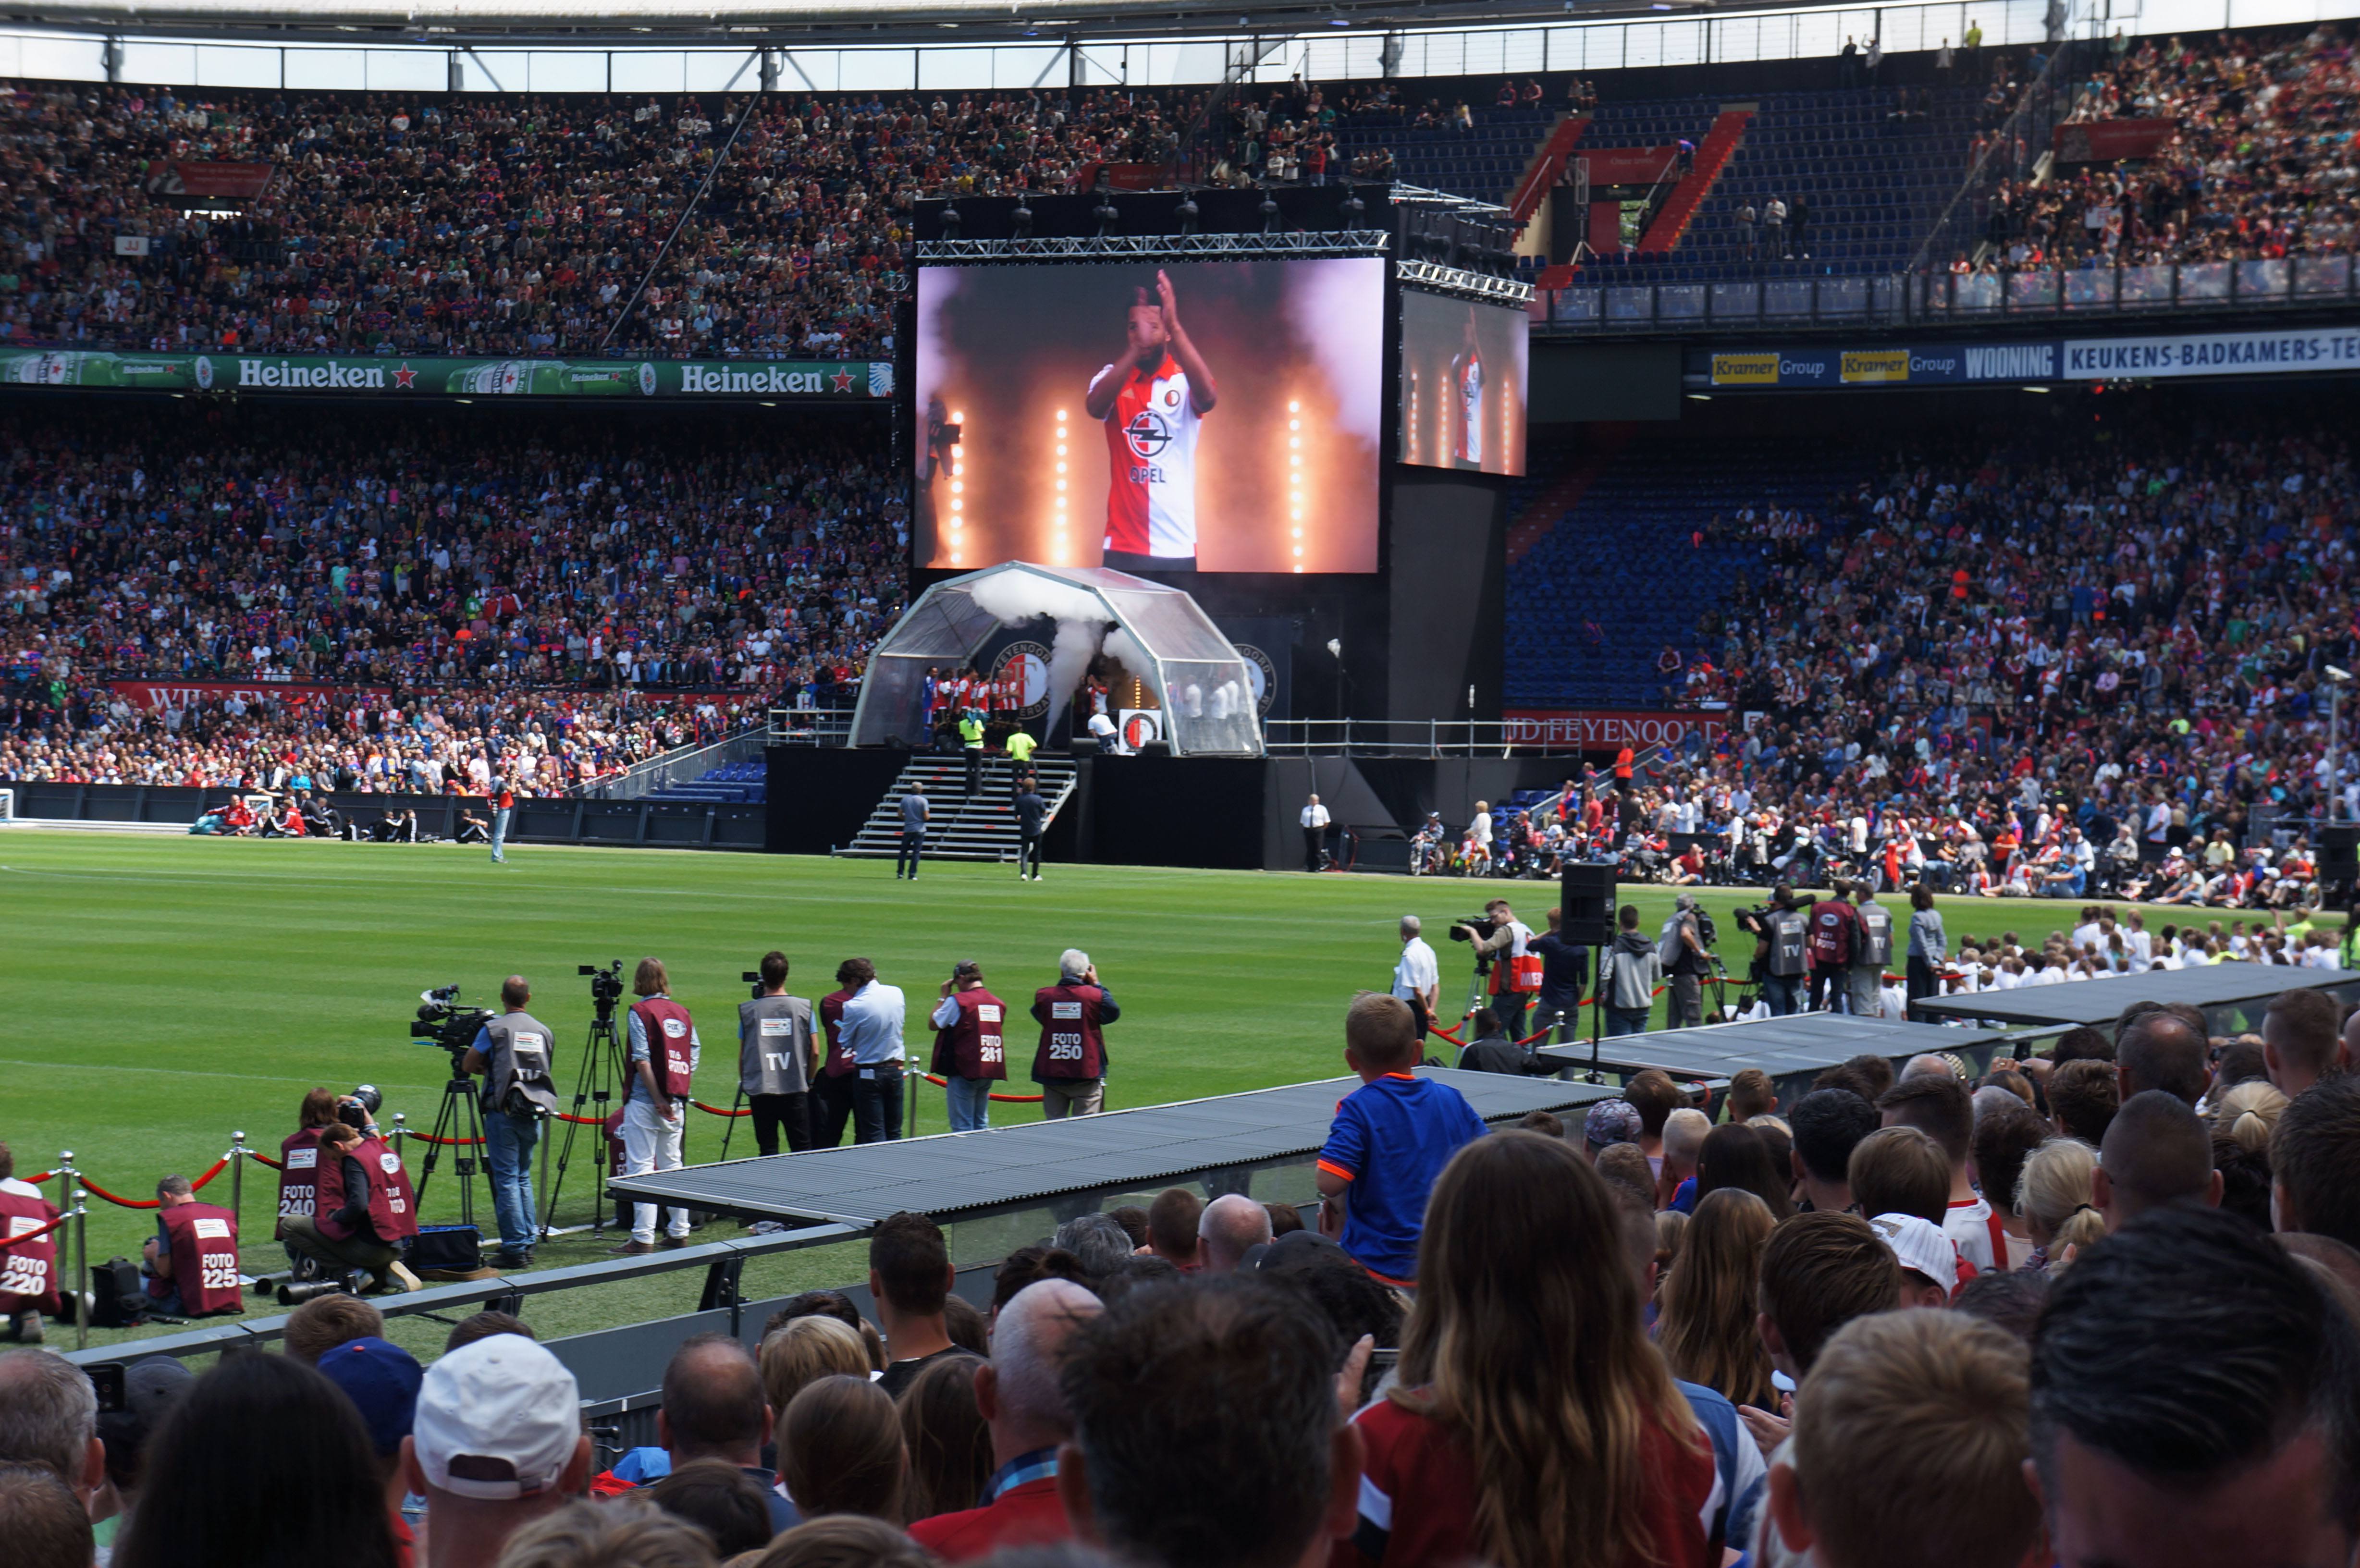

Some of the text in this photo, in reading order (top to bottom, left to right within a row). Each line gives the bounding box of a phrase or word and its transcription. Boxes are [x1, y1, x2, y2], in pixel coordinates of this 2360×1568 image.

[1715, 360, 1825, 378] Kramer Group
[1844, 356, 1956, 376] Kramer Group
[1965, 345, 2053, 379] WOONING
[239, 360, 385, 388] Heineken
[681, 366, 824, 392] Heineken
[1130, 466, 1166, 483] OPEL
[996, 643, 1052, 669] FEYENOOR
[1783, 944, 1800, 957] TV
[1872, 936, 1886, 949] TV
[980, 1034, 1002, 1047] FOTO
[1052, 1033, 1082, 1044] FOTO
[980, 1046, 1002, 1063] 241
[1049, 1044, 1082, 1060] 250
[766, 1052, 791, 1071] TV
[282, 1185, 316, 1199] FOTO
[278, 1199, 317, 1217] 240
[6, 1255, 48, 1275] FOTO
[202, 1253, 235, 1269] FOTO
[0, 1271, 46, 1296] 220
[202, 1267, 239, 1289] 225
